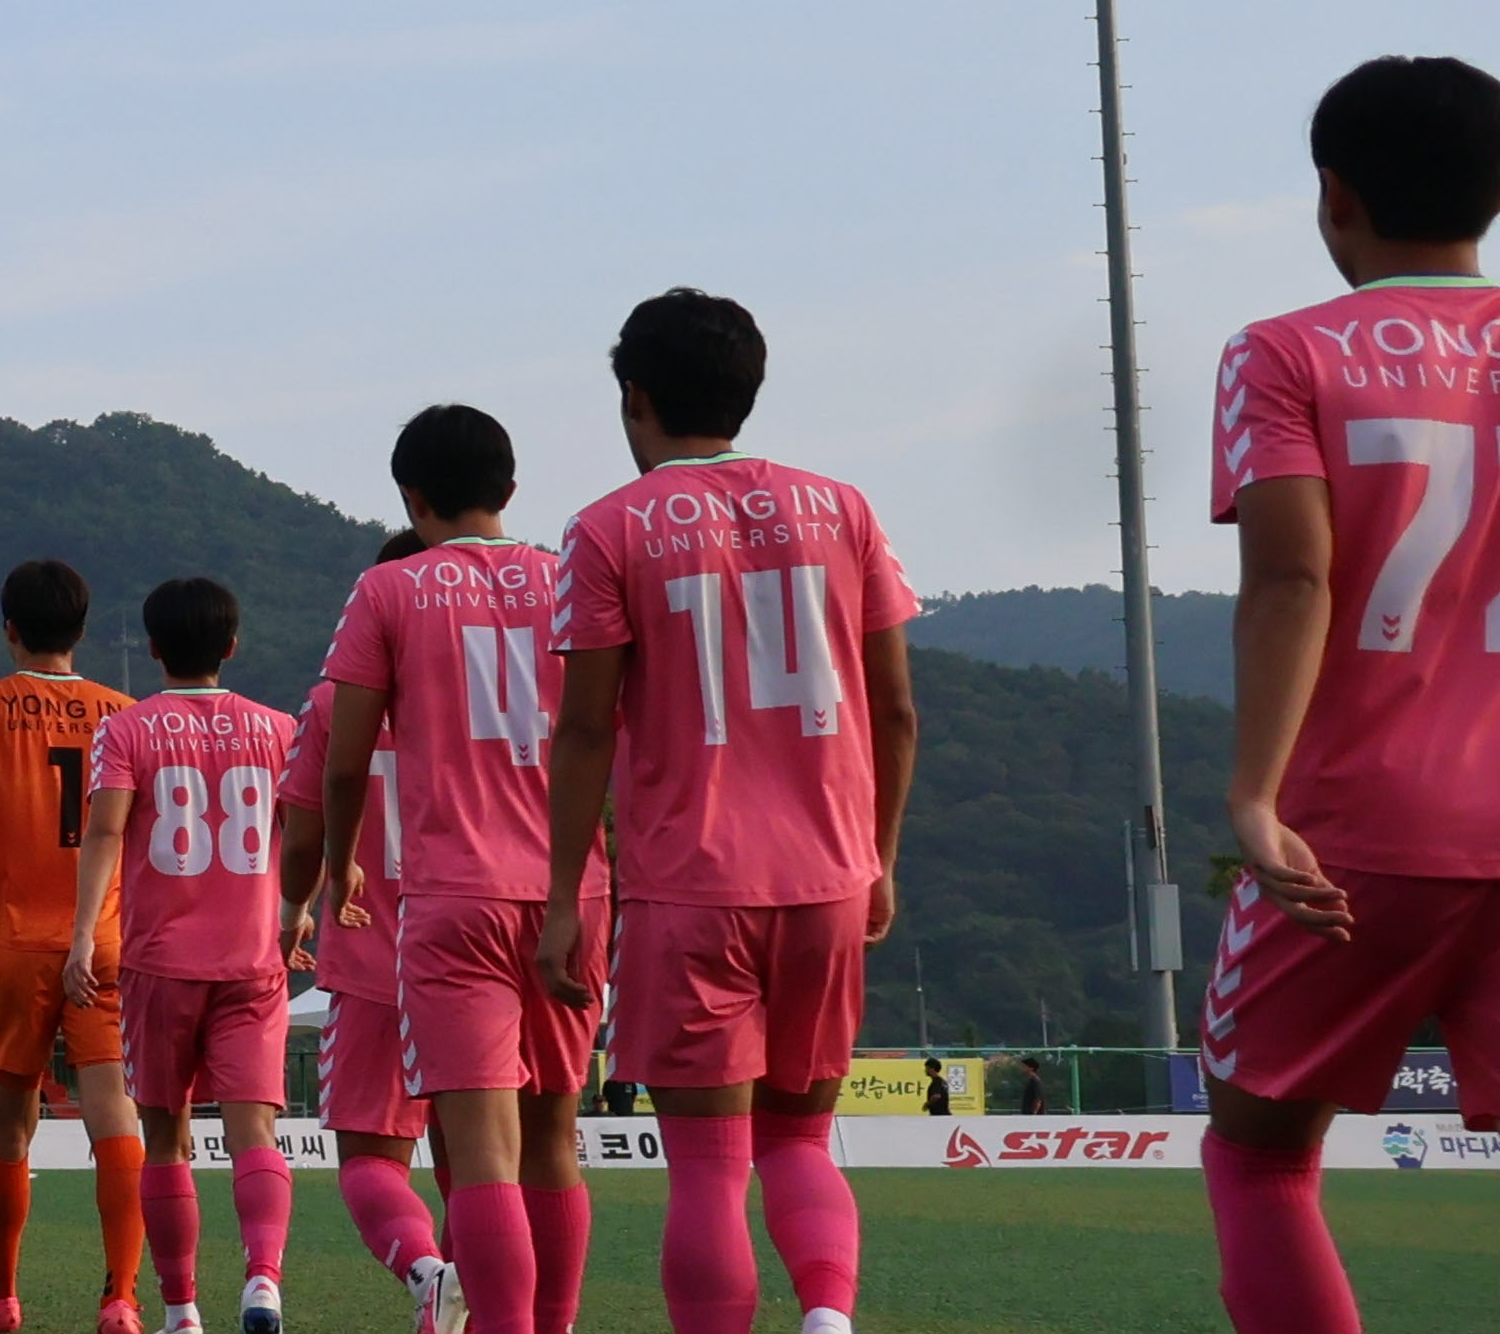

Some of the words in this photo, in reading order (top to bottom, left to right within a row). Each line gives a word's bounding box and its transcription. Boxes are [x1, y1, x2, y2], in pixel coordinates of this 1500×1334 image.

[627, 489, 776, 531] YONG
[790, 485, 840, 515] IN
[646, 522, 841, 558] UNIVERSITY
[1346, 418, 1500, 652] 7
[402, 562, 527, 589] YONG
[416, 591, 558, 609] UNIVERSI
[665, 565, 843, 745] 14
[1, 695, 86, 718] YONG
[462, 626, 549, 766] 4
[7, 720, 92, 734] UNIVERS
[140, 712, 233, 735] YONG
[245, 712, 273, 736] IN
[150, 737, 274, 753] UNIVERSITY
[48, 747, 83, 847] 1
[148, 765, 272, 875] 88
